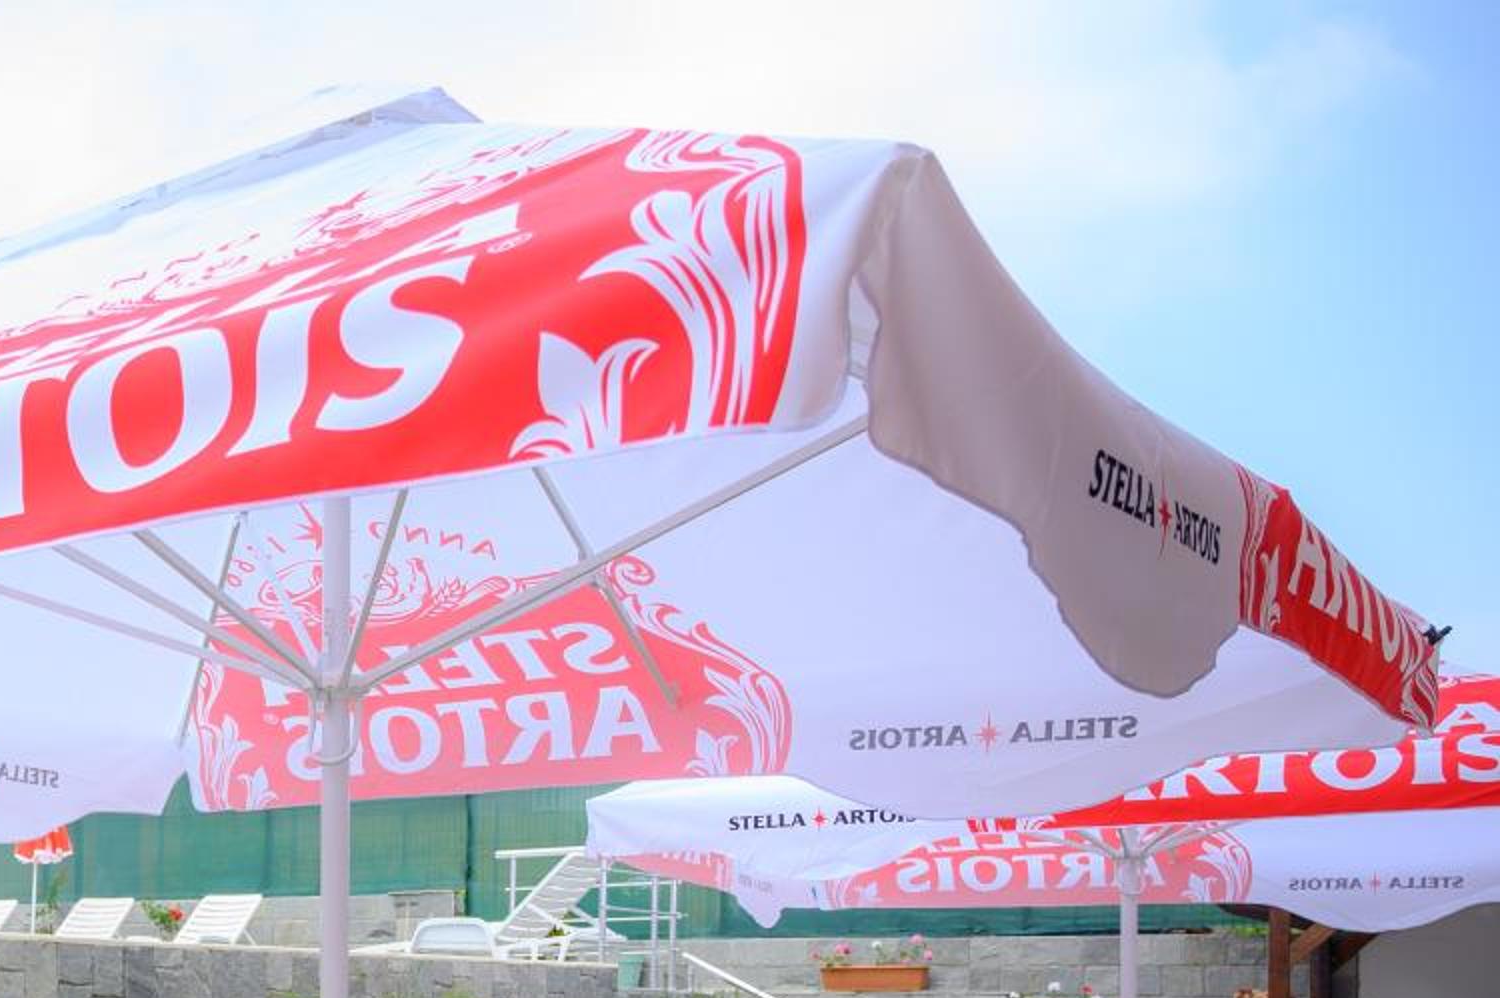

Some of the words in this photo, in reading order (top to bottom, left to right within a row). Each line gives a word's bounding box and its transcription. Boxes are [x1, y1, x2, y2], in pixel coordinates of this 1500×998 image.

[1088, 449, 1155, 528] STELLA
[1173, 500, 1221, 565] ARTOIS
[1124, 733, 1500, 800] RTOIS
[728, 812, 806, 831] STELLA
